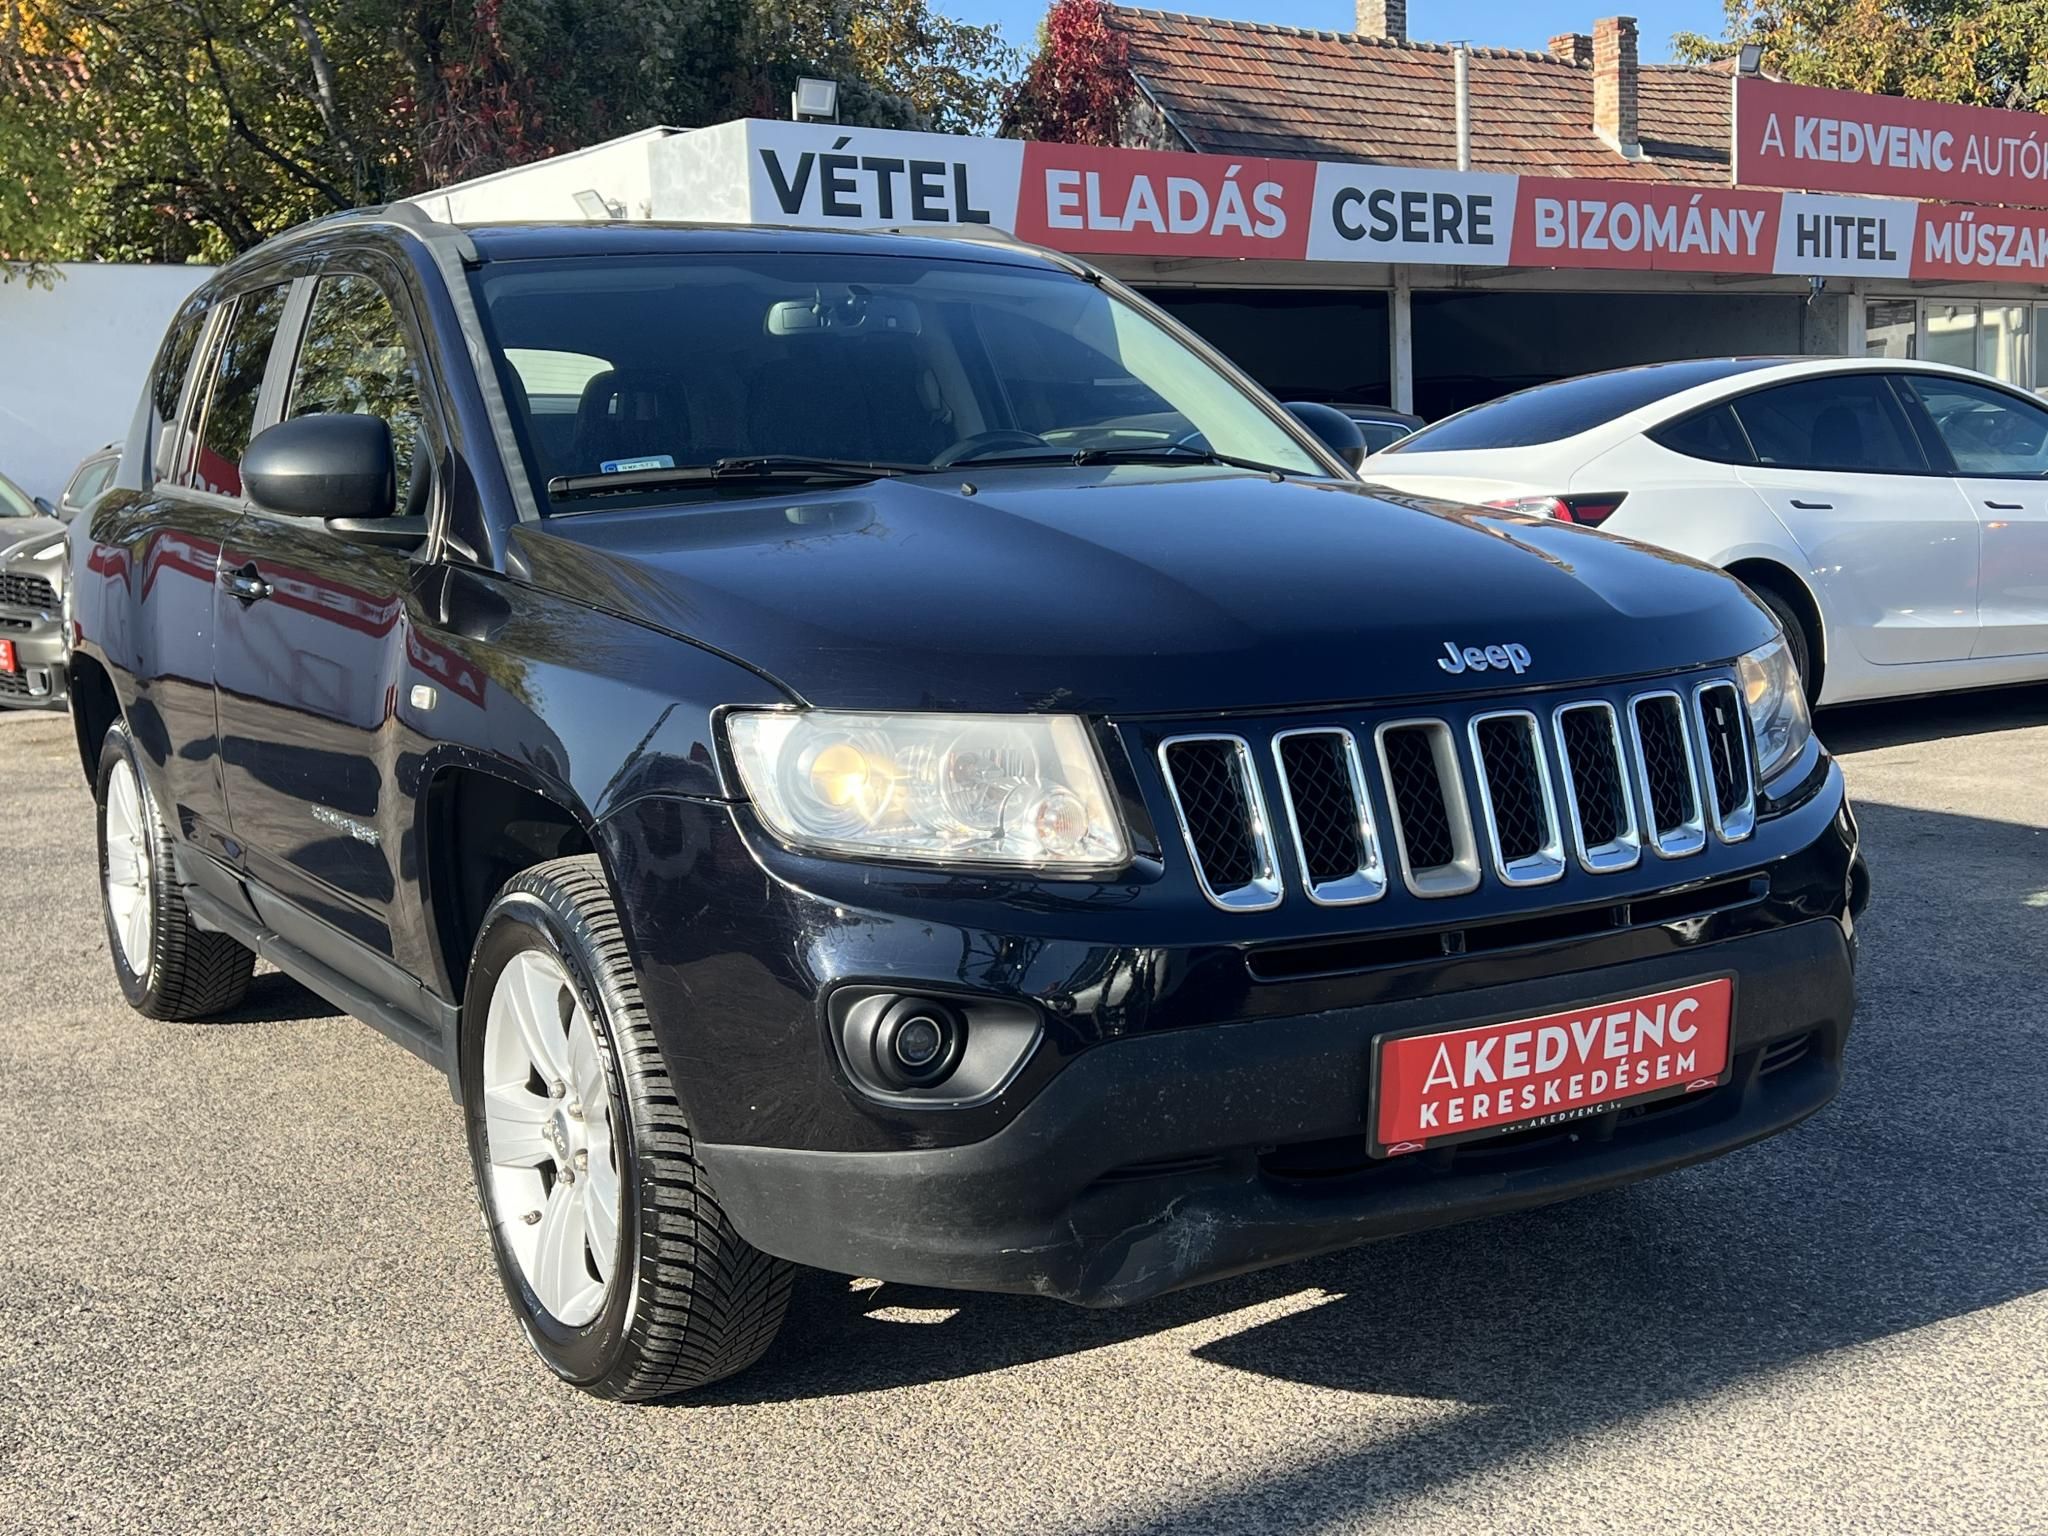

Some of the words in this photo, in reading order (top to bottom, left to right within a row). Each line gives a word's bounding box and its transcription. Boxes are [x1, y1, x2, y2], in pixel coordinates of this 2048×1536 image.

[1760, 112, 1785, 157] A
[1794, 116, 1955, 173] KEDVENC
[759, 136, 990, 224] VÉTEL
[1044, 164, 1288, 238] ELADÁS
[1332, 186, 1494, 245] CSERE
[1534, 194, 1766, 256] BIZOMÁNY
[1796, 213, 1897, 261] HITEL
[1437, 641, 1532, 674] Jeep
[1419, 1051, 1697, 1130] KERESKEDÉSEM
